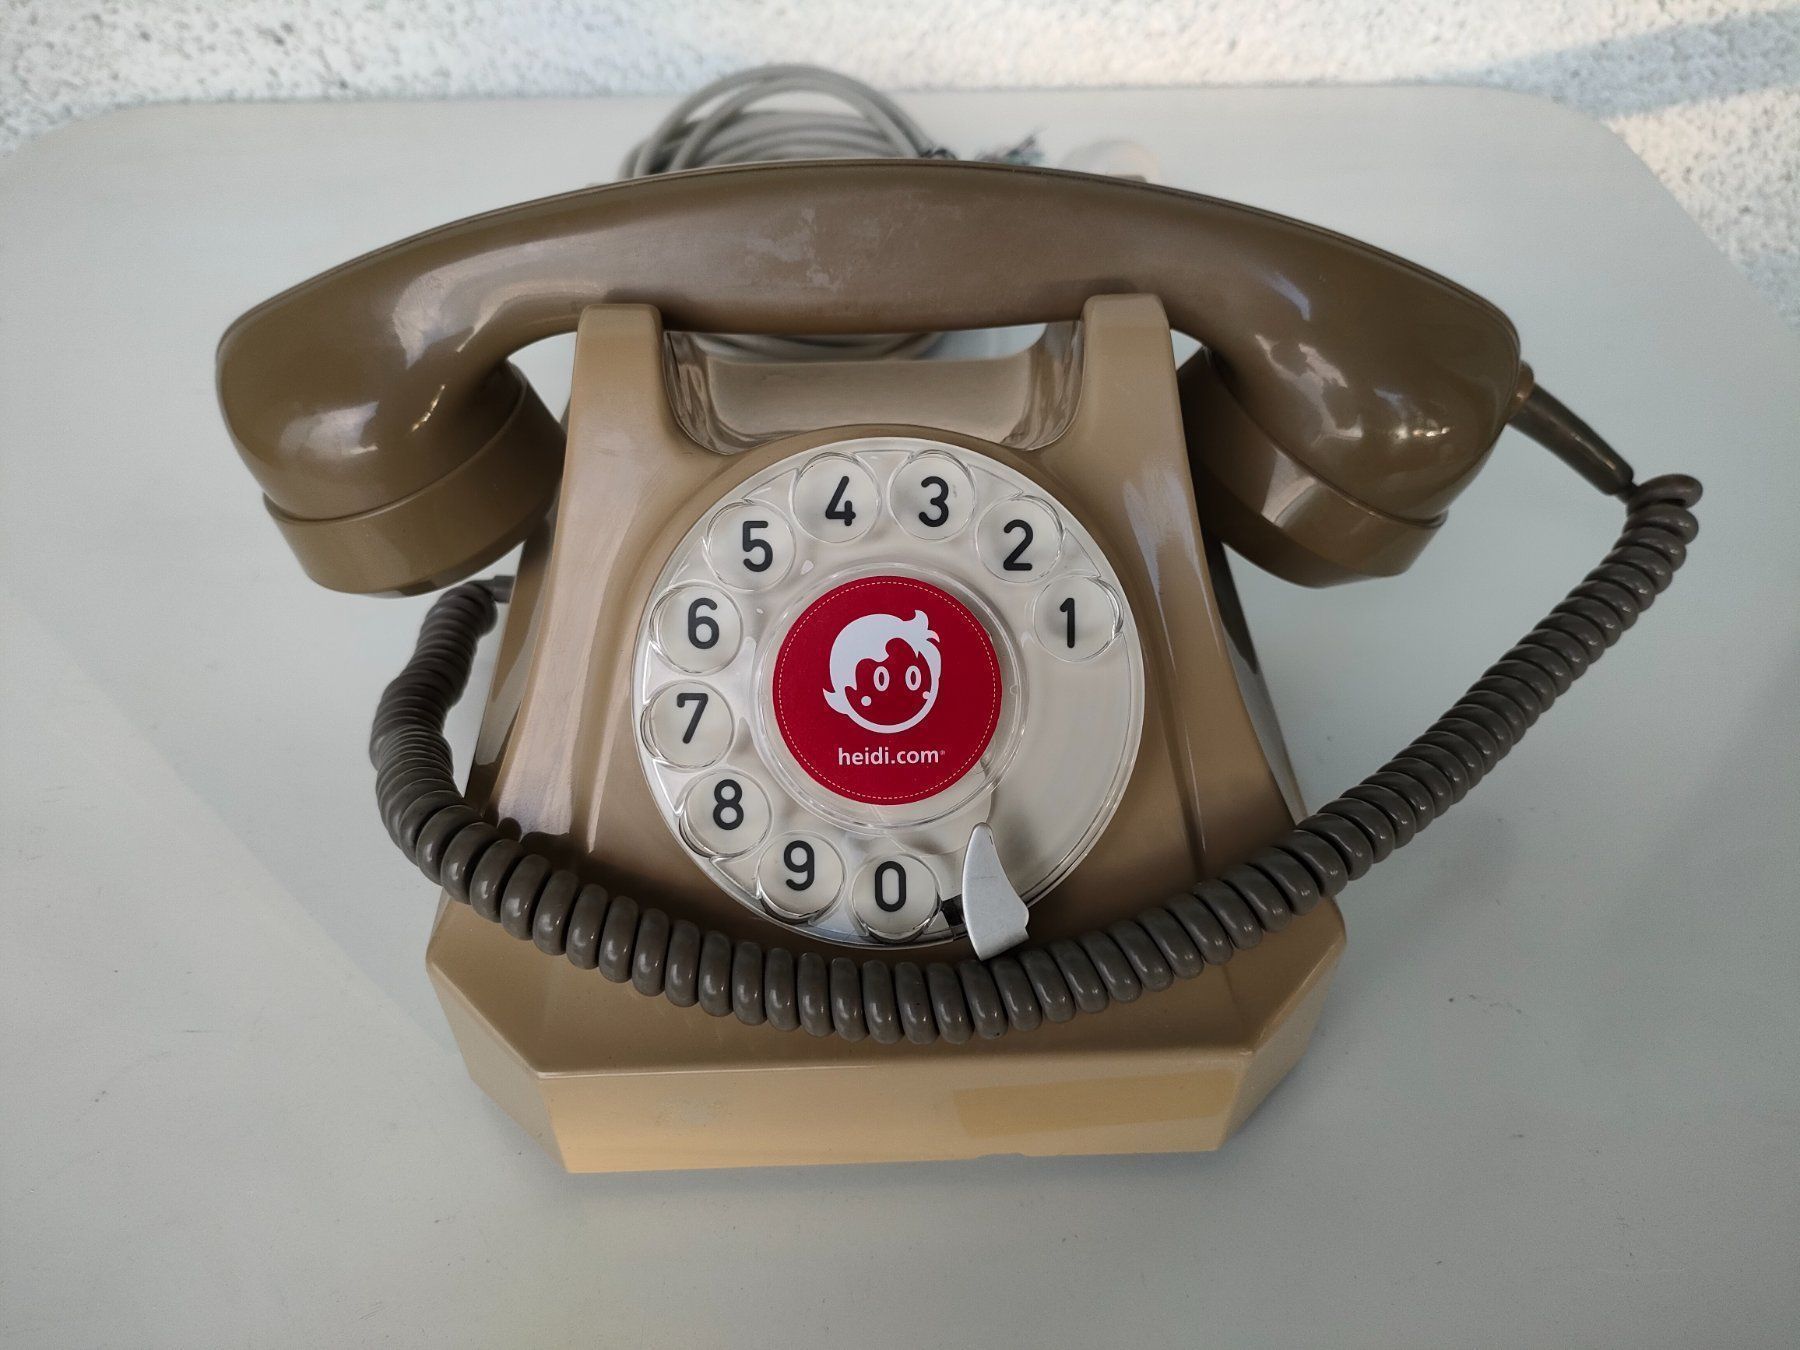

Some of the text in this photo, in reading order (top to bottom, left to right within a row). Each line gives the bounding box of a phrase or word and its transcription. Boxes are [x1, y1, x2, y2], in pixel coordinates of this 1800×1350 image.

[824, 475, 857, 527] 4
[918, 475, 950, 528] 3
[742, 520, 774, 573] 5
[1002, 518, 1034, 572] 2
[687, 597, 720, 650] 6
[1059, 597, 1076, 649] 1
[676, 692, 709, 745] 7
[838, 746, 939, 766] heidi.com
[712, 778, 745, 831] 8
[783, 839, 815, 892] 9
[874, 860, 907, 914] 0
